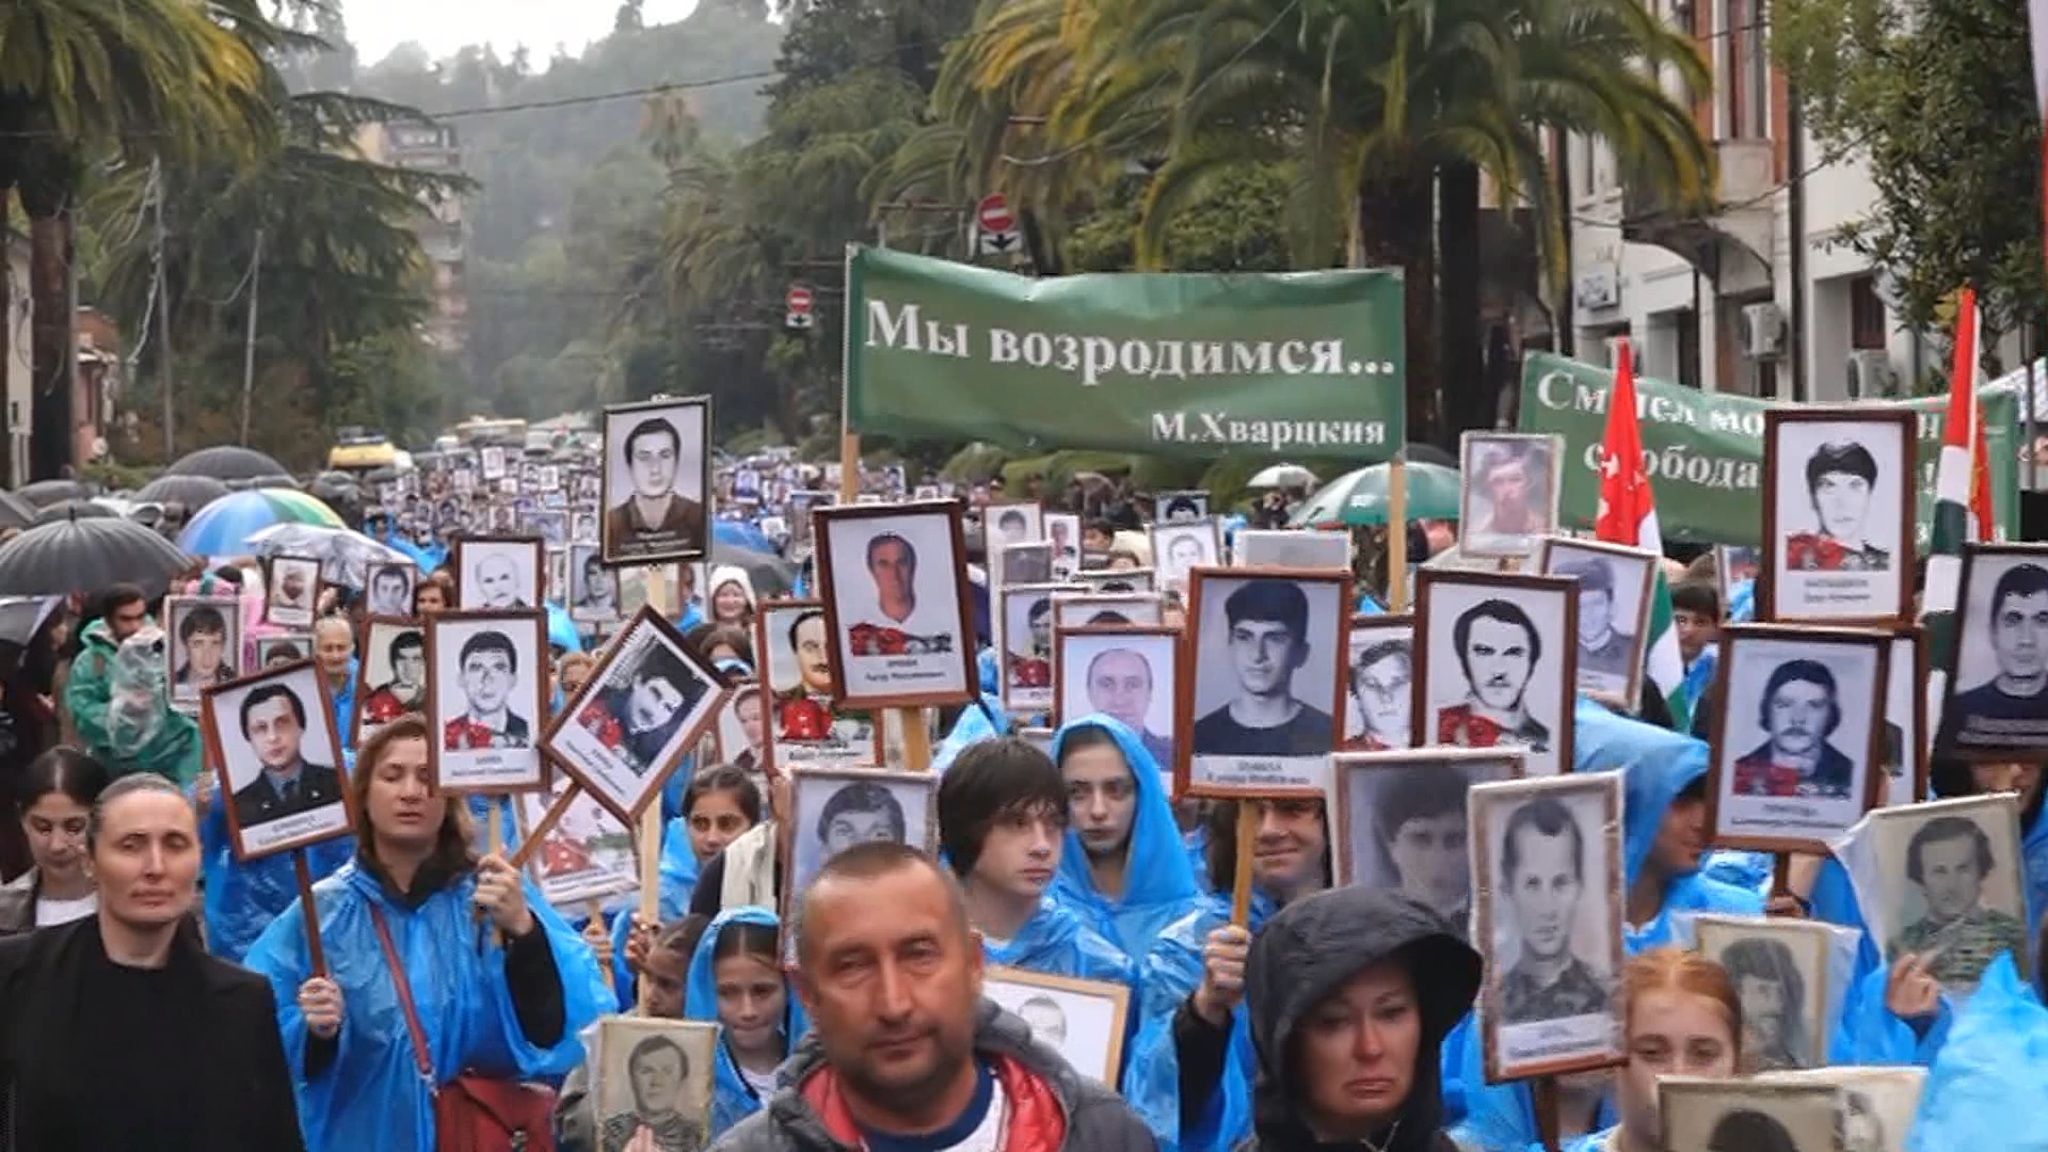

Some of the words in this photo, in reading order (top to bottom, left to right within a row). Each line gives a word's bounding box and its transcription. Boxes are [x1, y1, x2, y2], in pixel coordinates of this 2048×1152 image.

[865, 300, 970, 358] Мы
[989, 328, 1395, 386] возродимся...
[1537, 370, 1698, 426] Смсл
[1151, 411, 1387, 450] М.Хварцкия
[1583, 443, 1759, 490] собода
